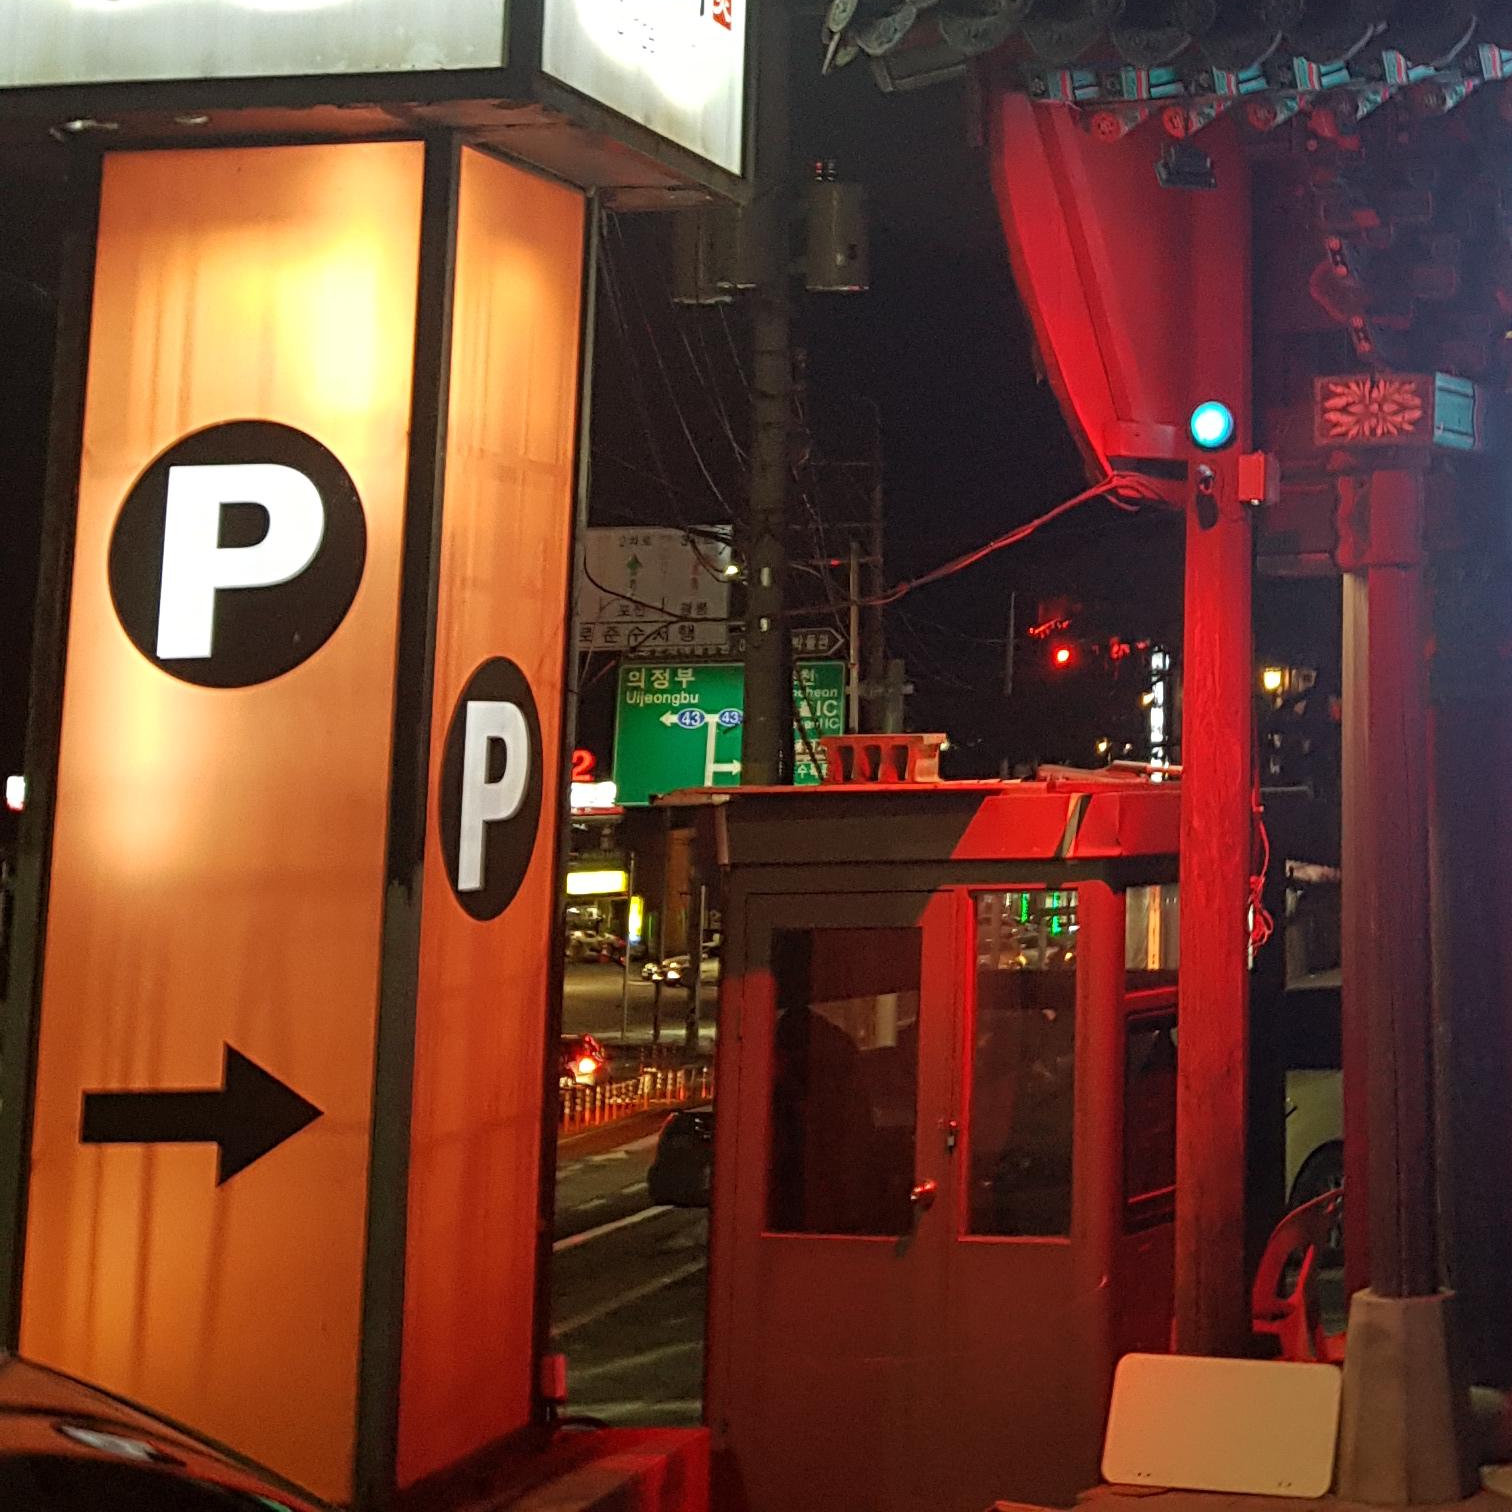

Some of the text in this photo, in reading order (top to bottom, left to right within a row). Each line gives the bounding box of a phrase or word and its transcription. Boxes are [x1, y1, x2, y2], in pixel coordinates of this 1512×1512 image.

[156, 463, 324, 659] P
[626, 668, 695, 689] 의정부
[626, 691, 699, 707] Uijeongbu
[682, 711, 700, 725] 43
[721, 710, 738, 724] 43
[458, 700, 529, 891] P
